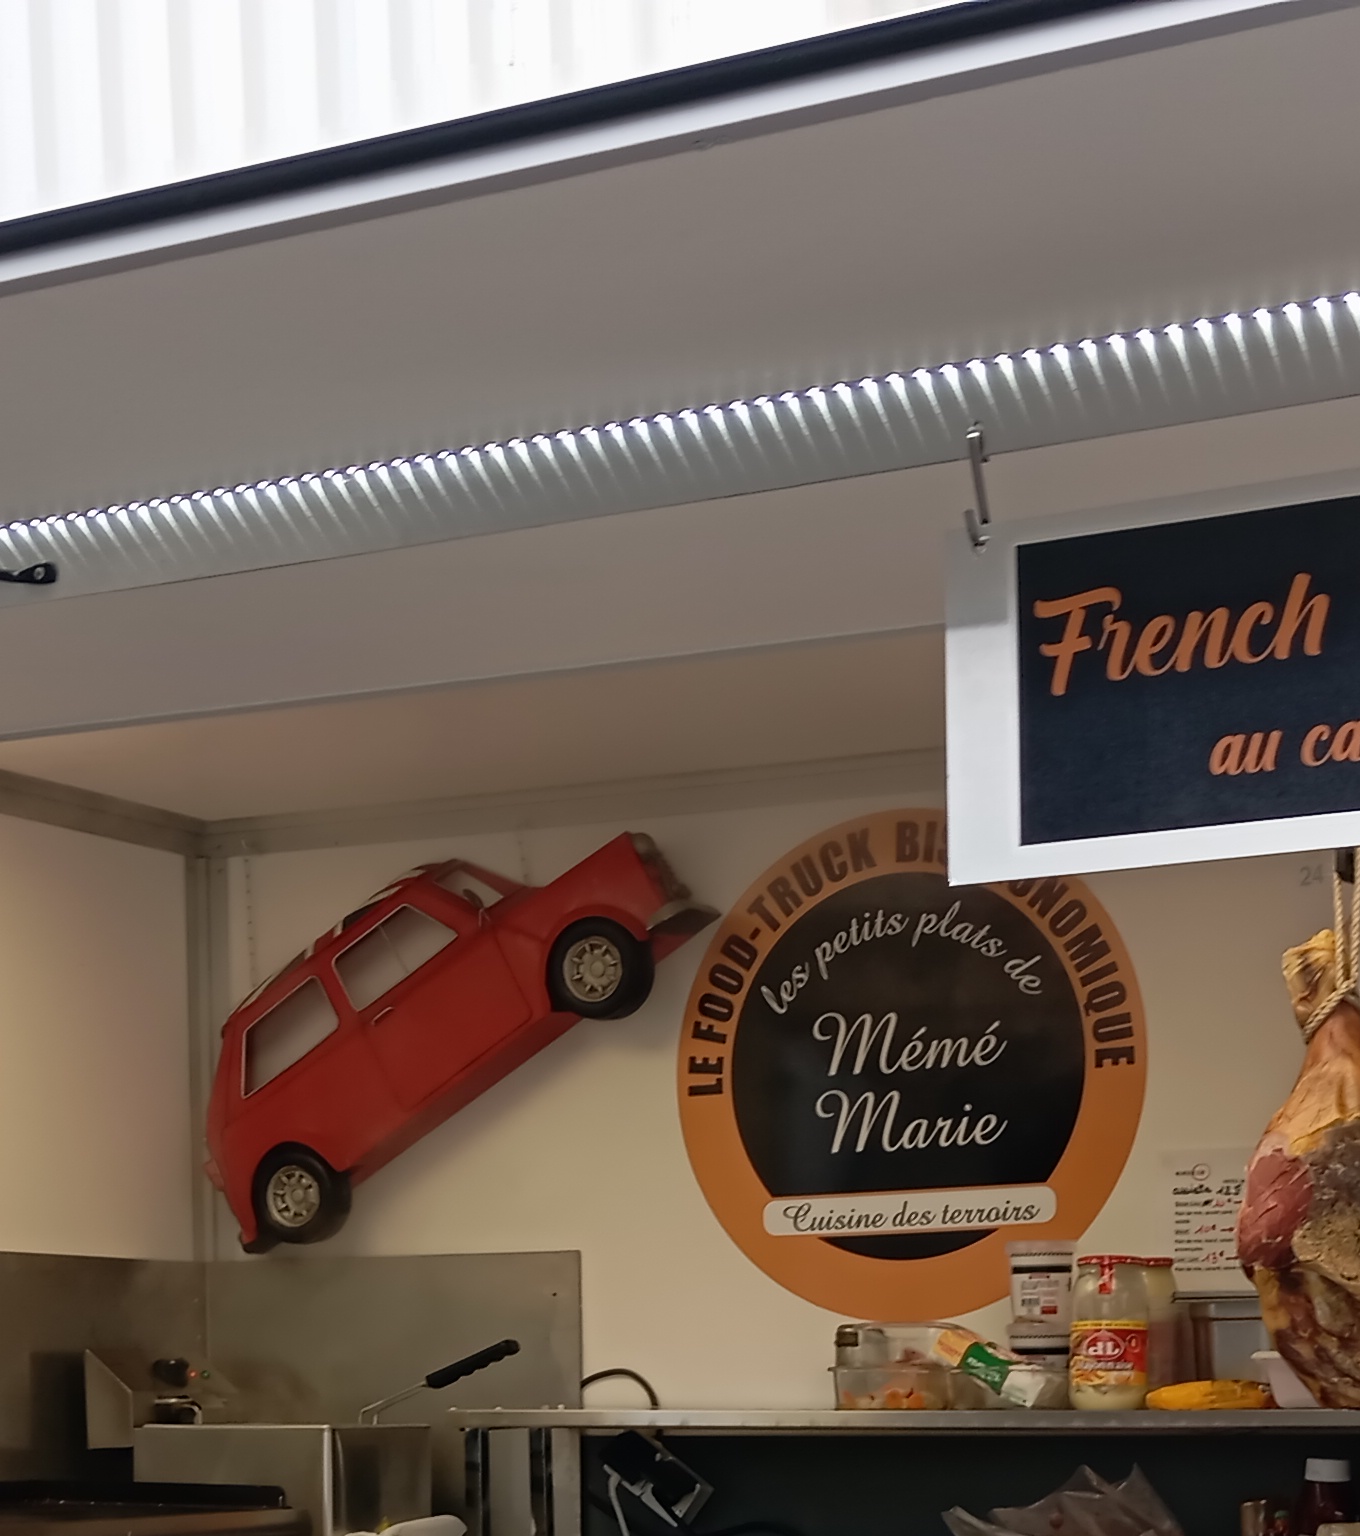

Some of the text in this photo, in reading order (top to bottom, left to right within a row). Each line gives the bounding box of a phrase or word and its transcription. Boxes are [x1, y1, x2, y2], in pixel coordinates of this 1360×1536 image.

[1035, 573, 1332, 696] French
[1208, 726, 1281, 776] au
[688, 821, 1134, 1096] LE FOOD-TRUCK BINOMIQUE
[815, 910, 909, 980] petits
[912, 901, 1007, 957] plats
[1004, 955, 1042, 995] de
[812, 1012, 1008, 1076] Mémé
[815, 1090, 1008, 1154] Marie
[783, 1200, 1040, 1232] Cuisine des terroirs
